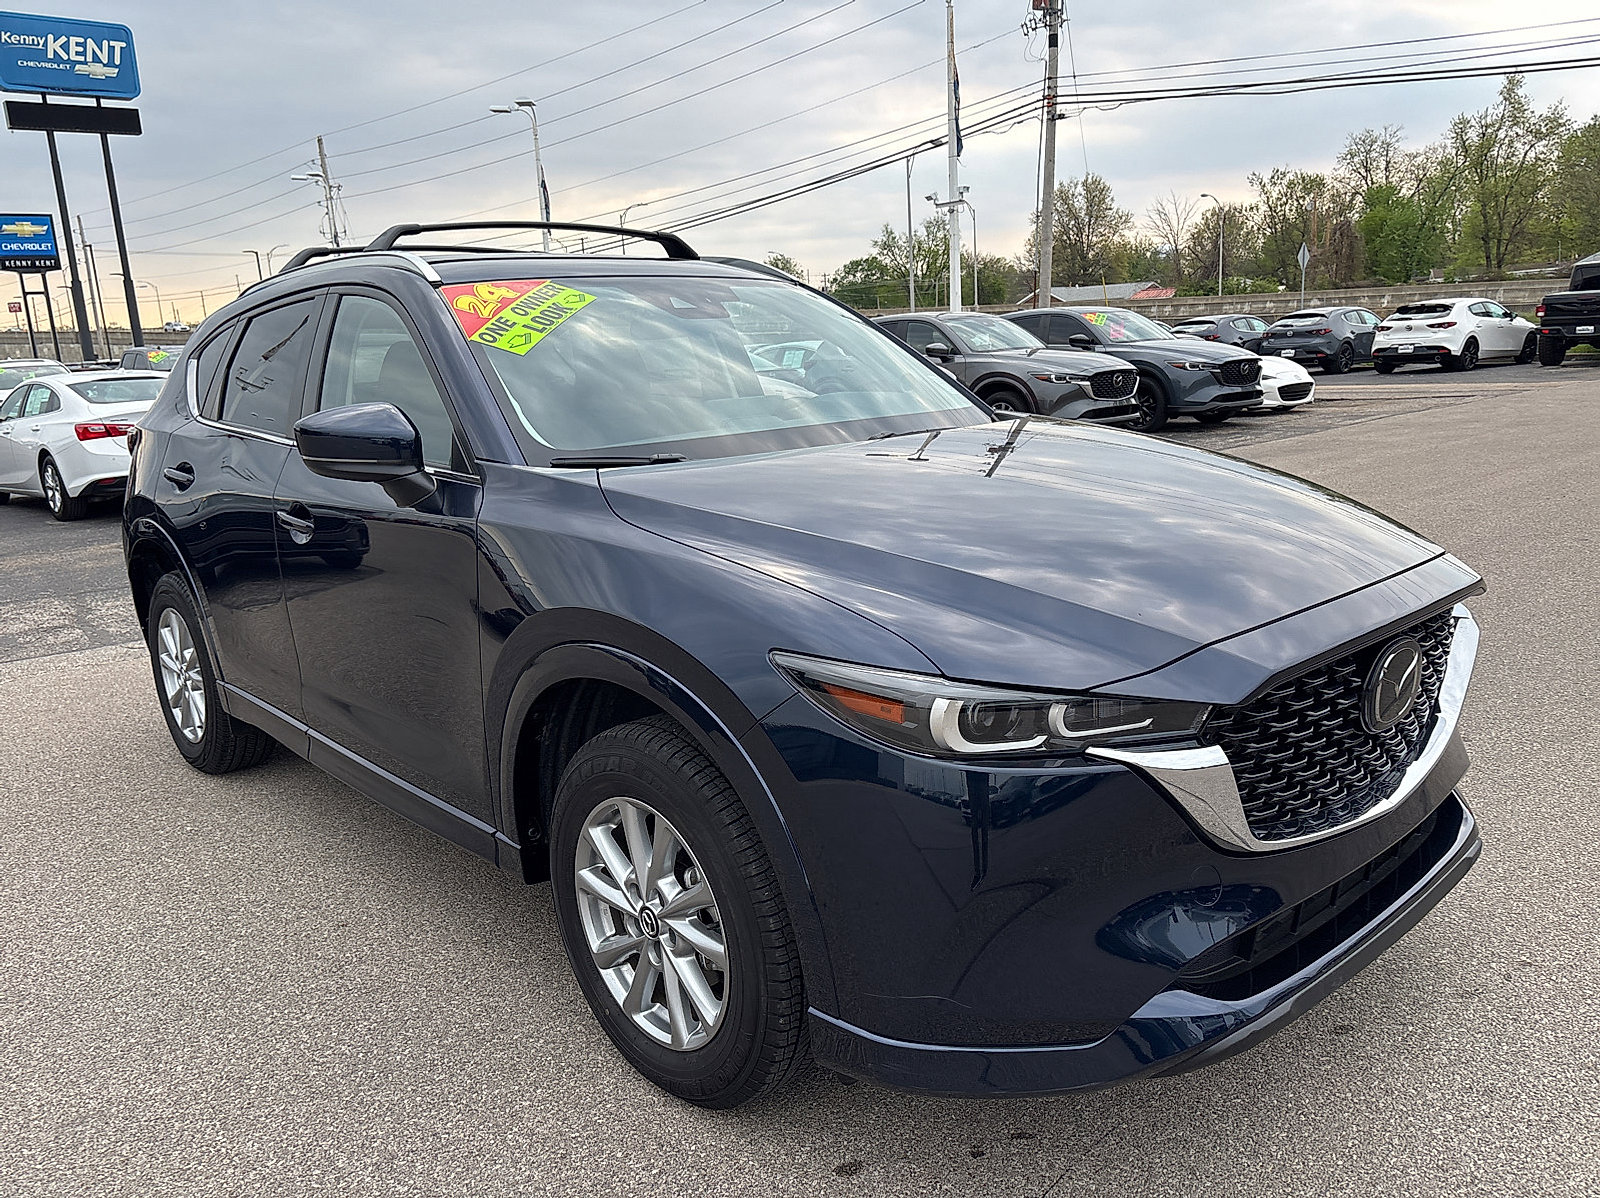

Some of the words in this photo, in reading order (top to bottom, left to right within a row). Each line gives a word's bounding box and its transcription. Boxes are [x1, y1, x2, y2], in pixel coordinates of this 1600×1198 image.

[0, 31, 46, 48] Kenny
[47, 33, 127, 66] KENT
[17, 60, 71, 70] CHEVROLET
[453, 284, 521, 319] 24
[478, 316, 518, 344] ONE
[510, 284, 567, 318] OWNER
[521, 301, 574, 334] LOOK
